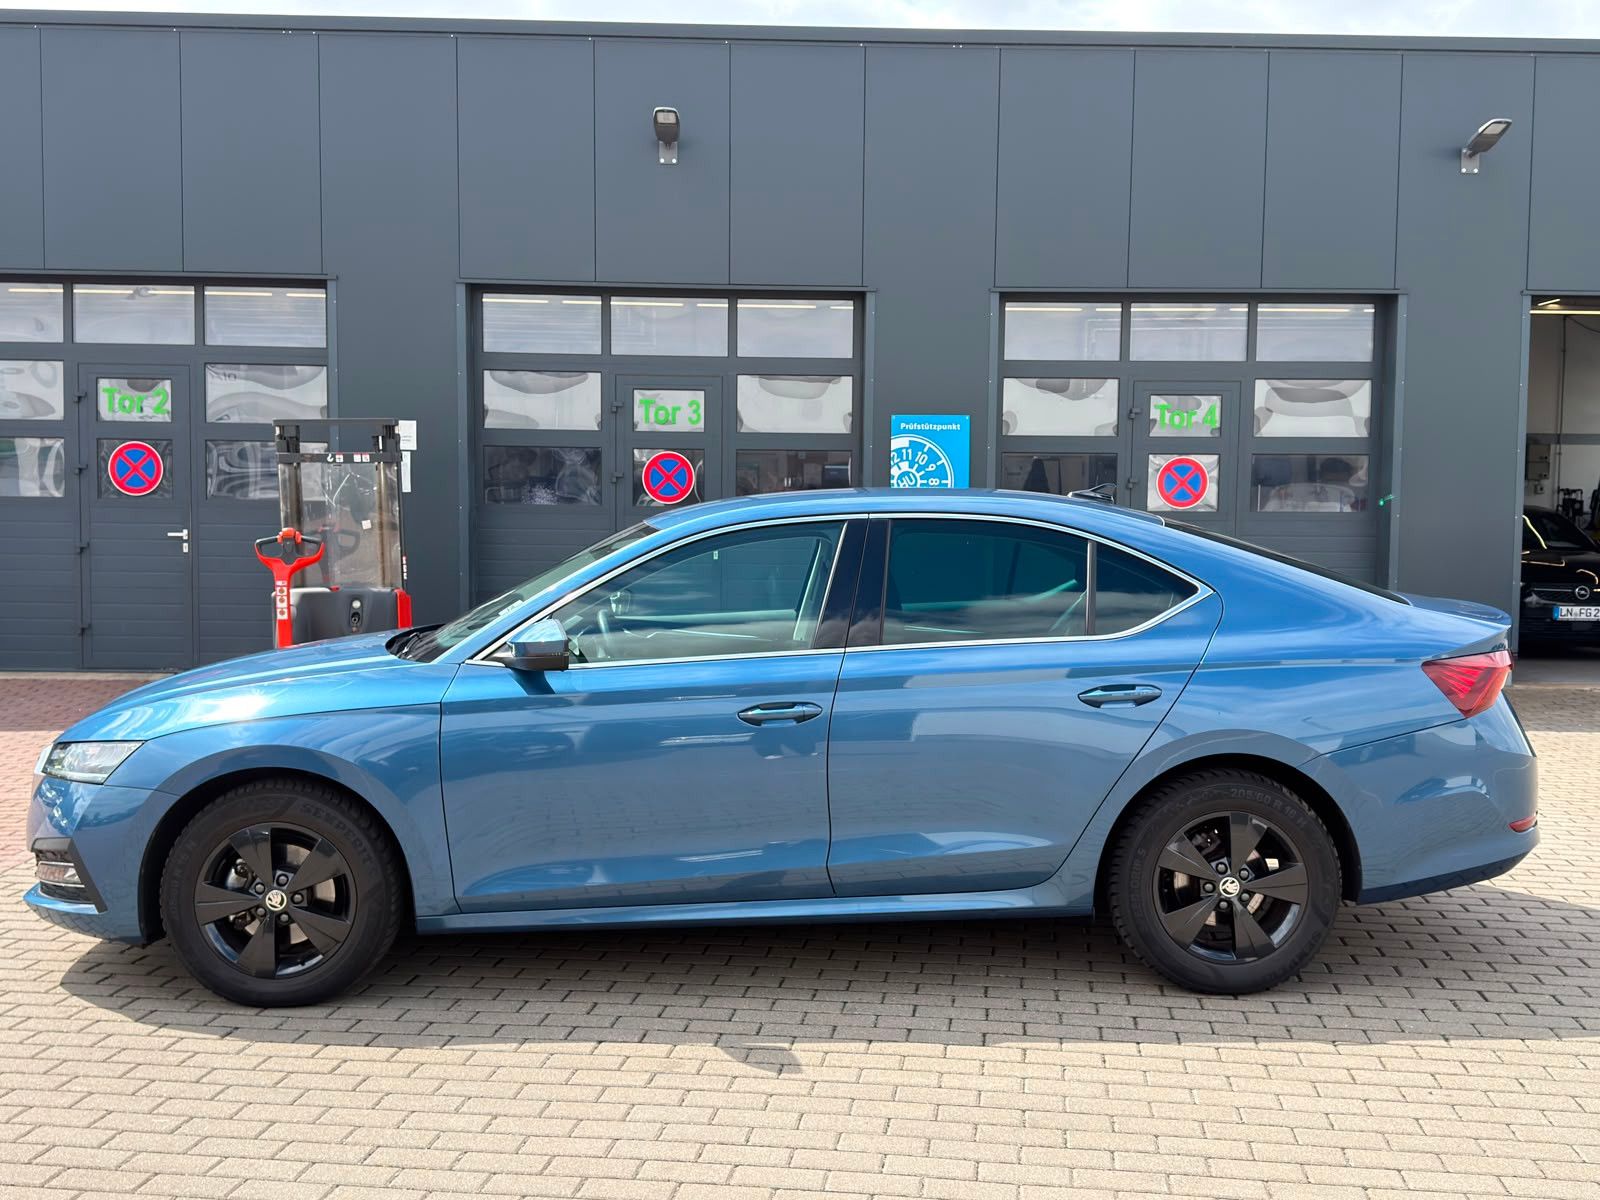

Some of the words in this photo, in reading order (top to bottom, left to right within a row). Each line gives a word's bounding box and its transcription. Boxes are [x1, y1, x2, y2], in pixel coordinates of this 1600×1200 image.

[102, 387, 148, 414] Tor
[152, 387, 169, 415] 2
[639, 398, 681, 425] Tor
[687, 399, 702, 425] 3
[1153, 403, 1198, 430] Tor
[1202, 402, 1217, 429] 4
[900, 422, 961, 431] Prüfstützpunkt
[901, 448, 913, 460] 11
[914, 451, 928, 465] 10
